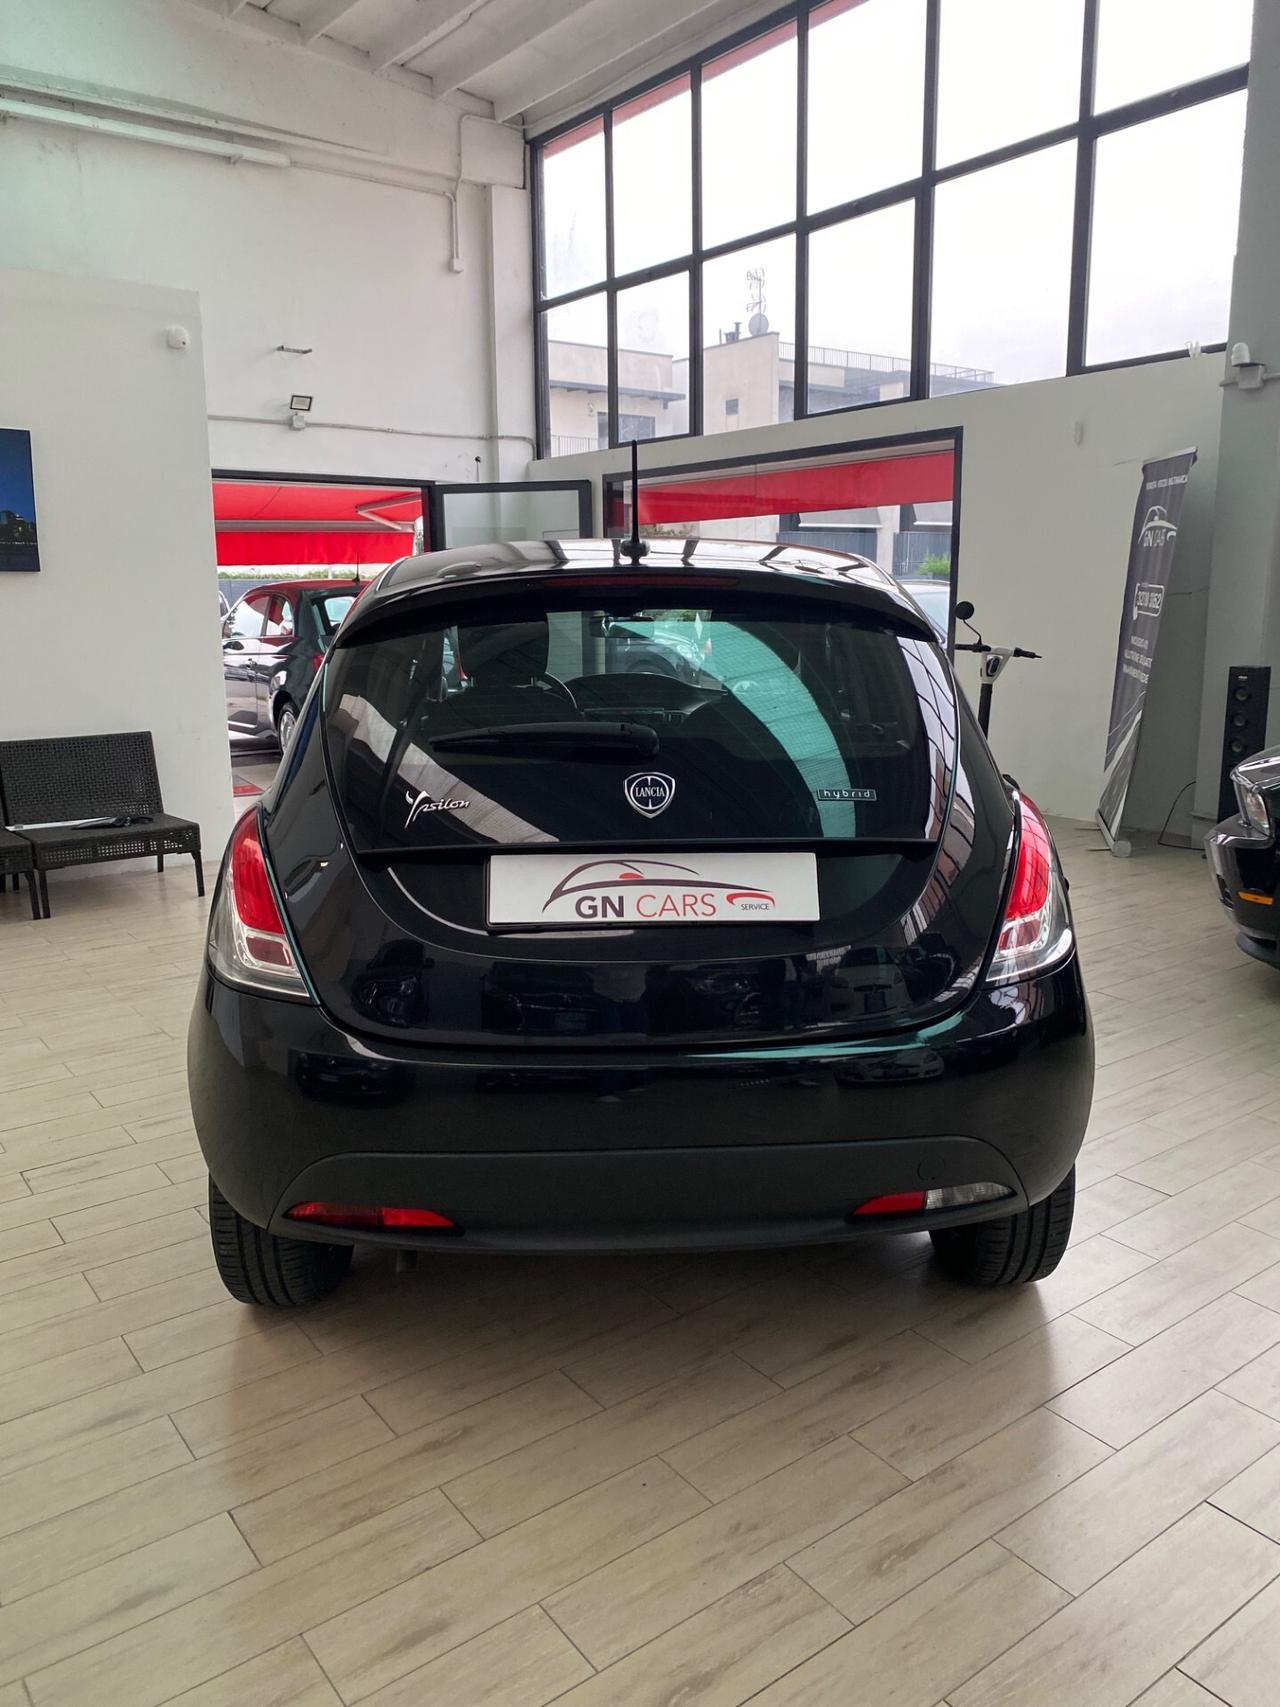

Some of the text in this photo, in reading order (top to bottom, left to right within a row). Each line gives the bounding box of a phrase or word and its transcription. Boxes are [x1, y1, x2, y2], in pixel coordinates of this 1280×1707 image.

[635, 786, 665, 798] LANCIA
[823, 789, 870, 799] hybrid
[404, 790, 471, 829] Ypsilon
[575, 893, 770, 919] GN CARS SERVICE
